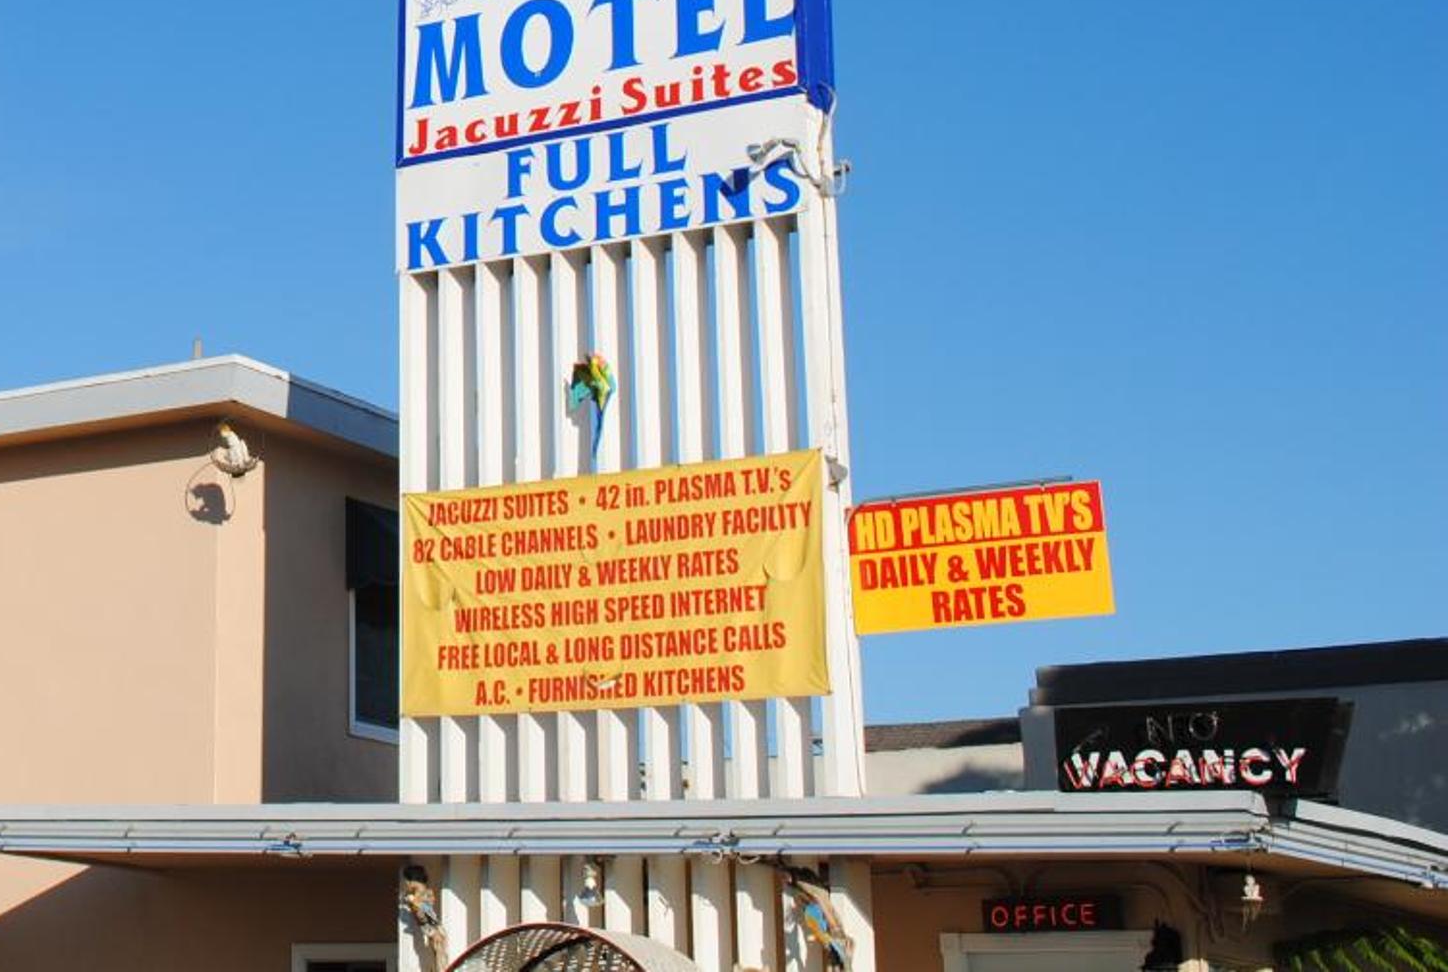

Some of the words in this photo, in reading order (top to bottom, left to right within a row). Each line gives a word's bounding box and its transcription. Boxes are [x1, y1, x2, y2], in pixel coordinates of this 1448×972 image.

[408, 86, 601, 156] Jacuzzi
[621, 59, 797, 113] Suites
[506, 122, 687, 199] FULL
[406, 158, 801, 270] KITCHENS
[428, 497, 498, 526] JACUZZI
[503, 490, 569, 520] SUITES
[595, 484, 620, 511] 42
[625, 484, 649, 508] in.
[655, 471, 736, 505] PLASMA
[413, 538, 435, 563] 82
[440, 533, 497, 561] CABLE
[502, 524, 598, 557] CHANNELS
[625, 511, 717, 546] LAUNDRY
[722, 501, 812, 536] FACILITY
[854, 509, 896, 552] HD
[900, 496, 1021, 548] PLASMA
[476, 567, 516, 595] LOW
[521, 563, 572, 592] DAILY
[578, 565, 591, 587] &
[596, 554, 672, 586] WEEKLY
[677, 548, 739, 579] RATES
[858, 553, 938, 591] DAILY
[947, 555, 969, 583] &
[975, 537, 1096, 581] WEEKLY
[454, 602, 545, 633] WIRELESS
[551, 598, 599, 627] HIGH
[604, 594, 665, 623] SPEED
[670, 585, 768, 618] INTERNET
[931, 584, 1026, 624] RATES
[438, 644, 480, 670] FREE
[484, 640, 541, 668] LOCAL
[546, 643, 559, 664] &
[564, 635, 615, 663] LONG
[620, 627, 719, 660] DISTANCE
[723, 621, 787, 653] CALLS
[475, 679, 511, 706] A.C.
[643, 664, 745, 697] KITCHENS
[1145, 711, 1220, 744] NO
[1063, 746, 1307, 789] VACANCY
[991, 902, 1096, 928] OFFICE
